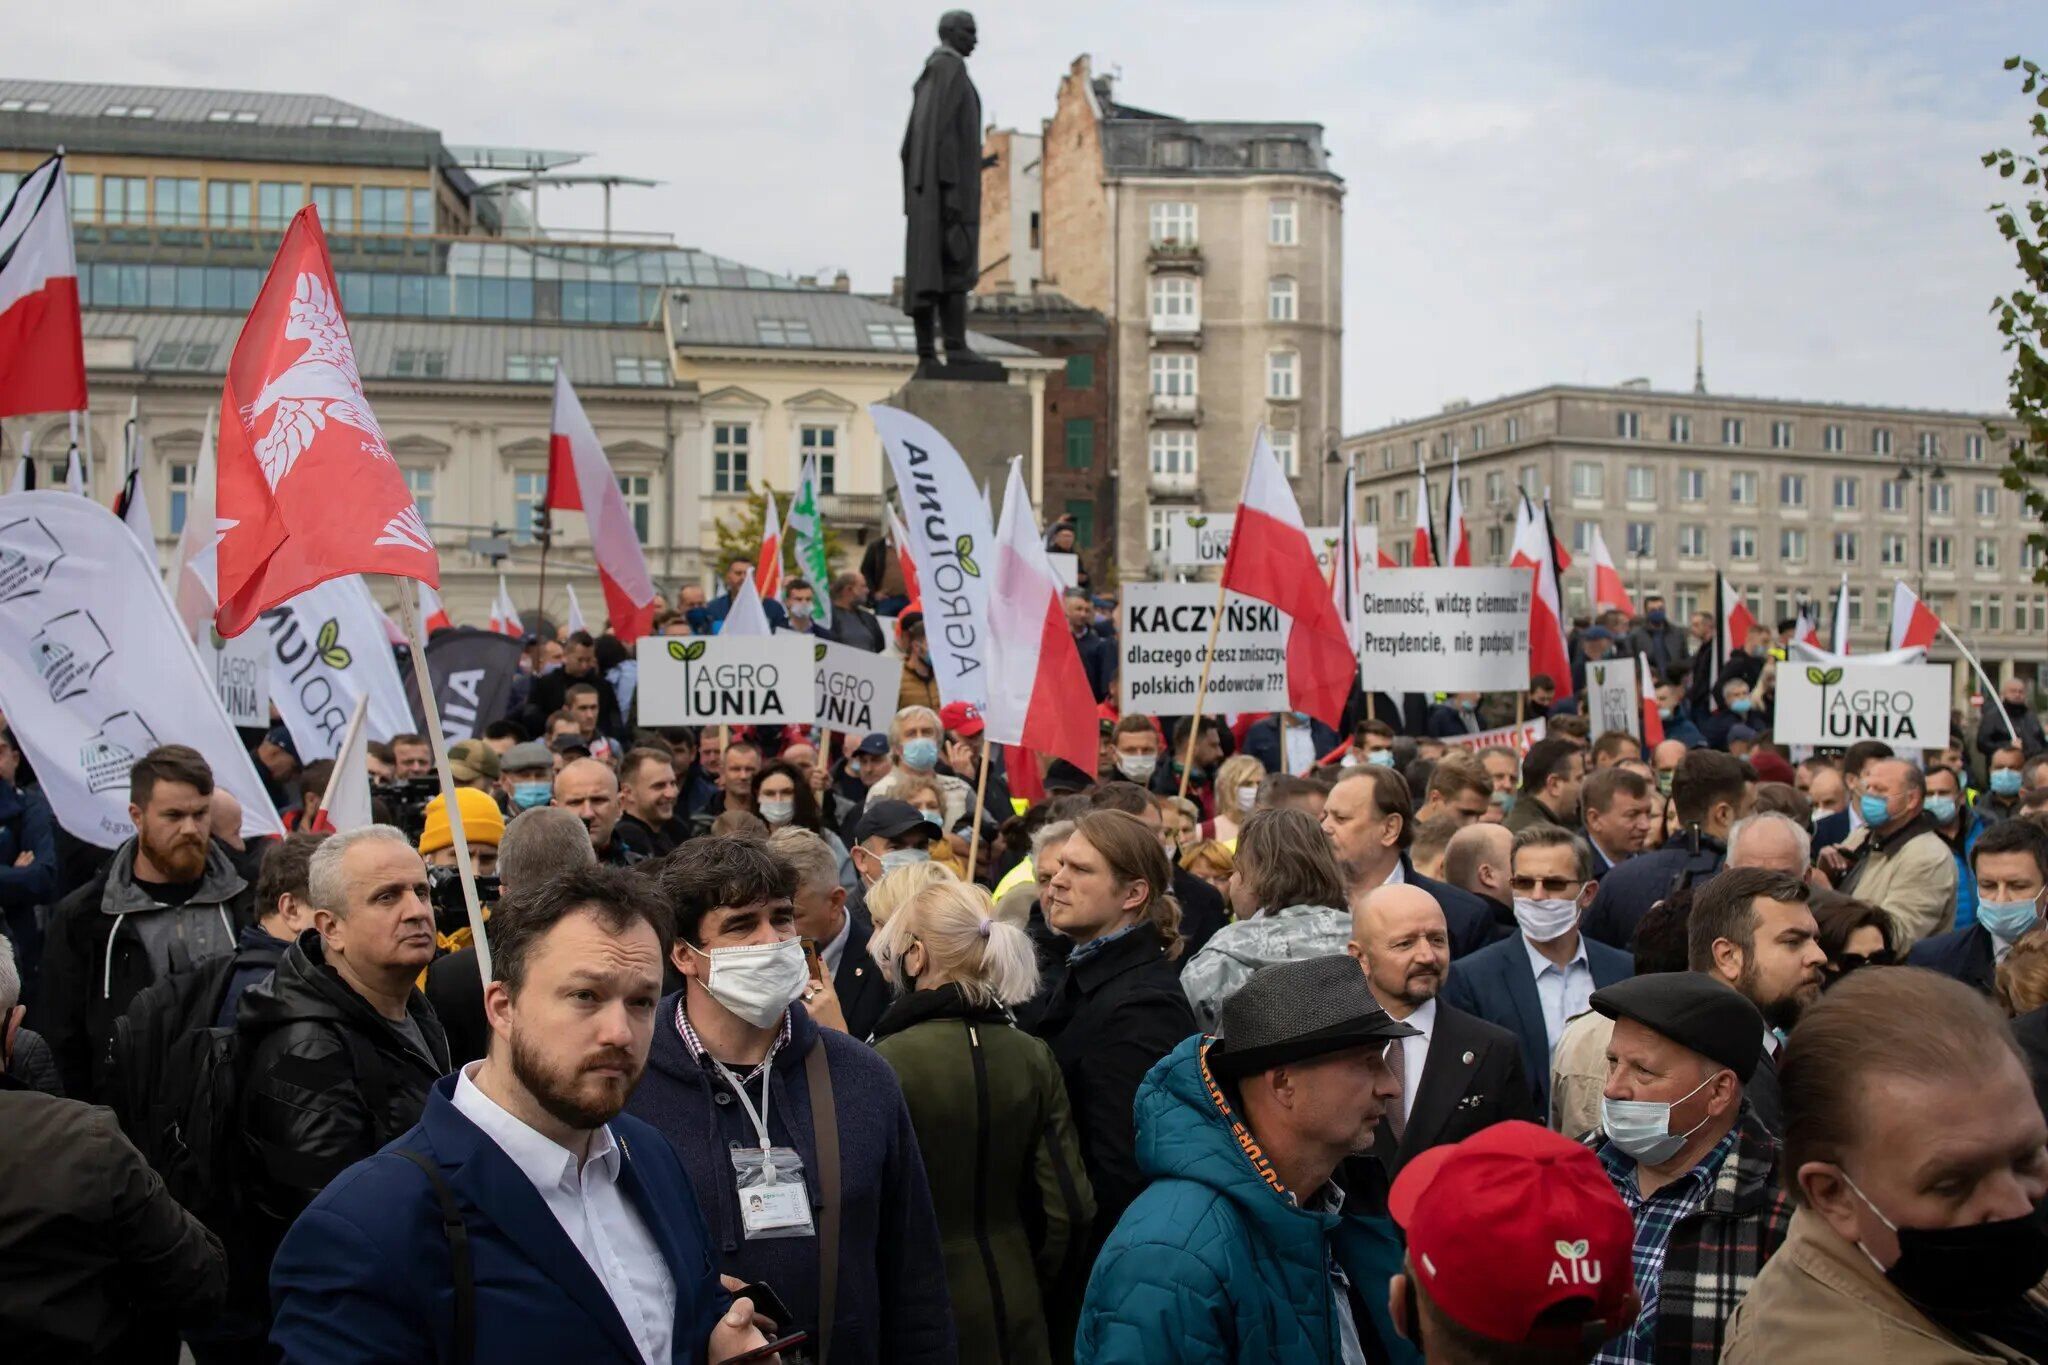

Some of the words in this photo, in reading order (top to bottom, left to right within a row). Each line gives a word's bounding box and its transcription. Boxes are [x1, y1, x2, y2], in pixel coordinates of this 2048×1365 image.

[1202, 544, 1229, 560] UN
[1364, 592, 1430, 617] Ciemność,
[1435, 592, 1472, 618] widzę
[1128, 645, 1192, 667] dlaczego
[1365, 631, 1446, 656] Prezydencie,
[1454, 631, 1473, 651] nie
[694, 664, 779, 689] AGRO
[815, 668, 875, 703] AGRO
[1132, 674, 1194, 699] polskich
[1267, 672, 1284, 692] ???
[694, 690, 784, 717] UNIA
[1831, 690, 1914, 714] AGRO
[1830, 714, 1917, 739] UNIA
